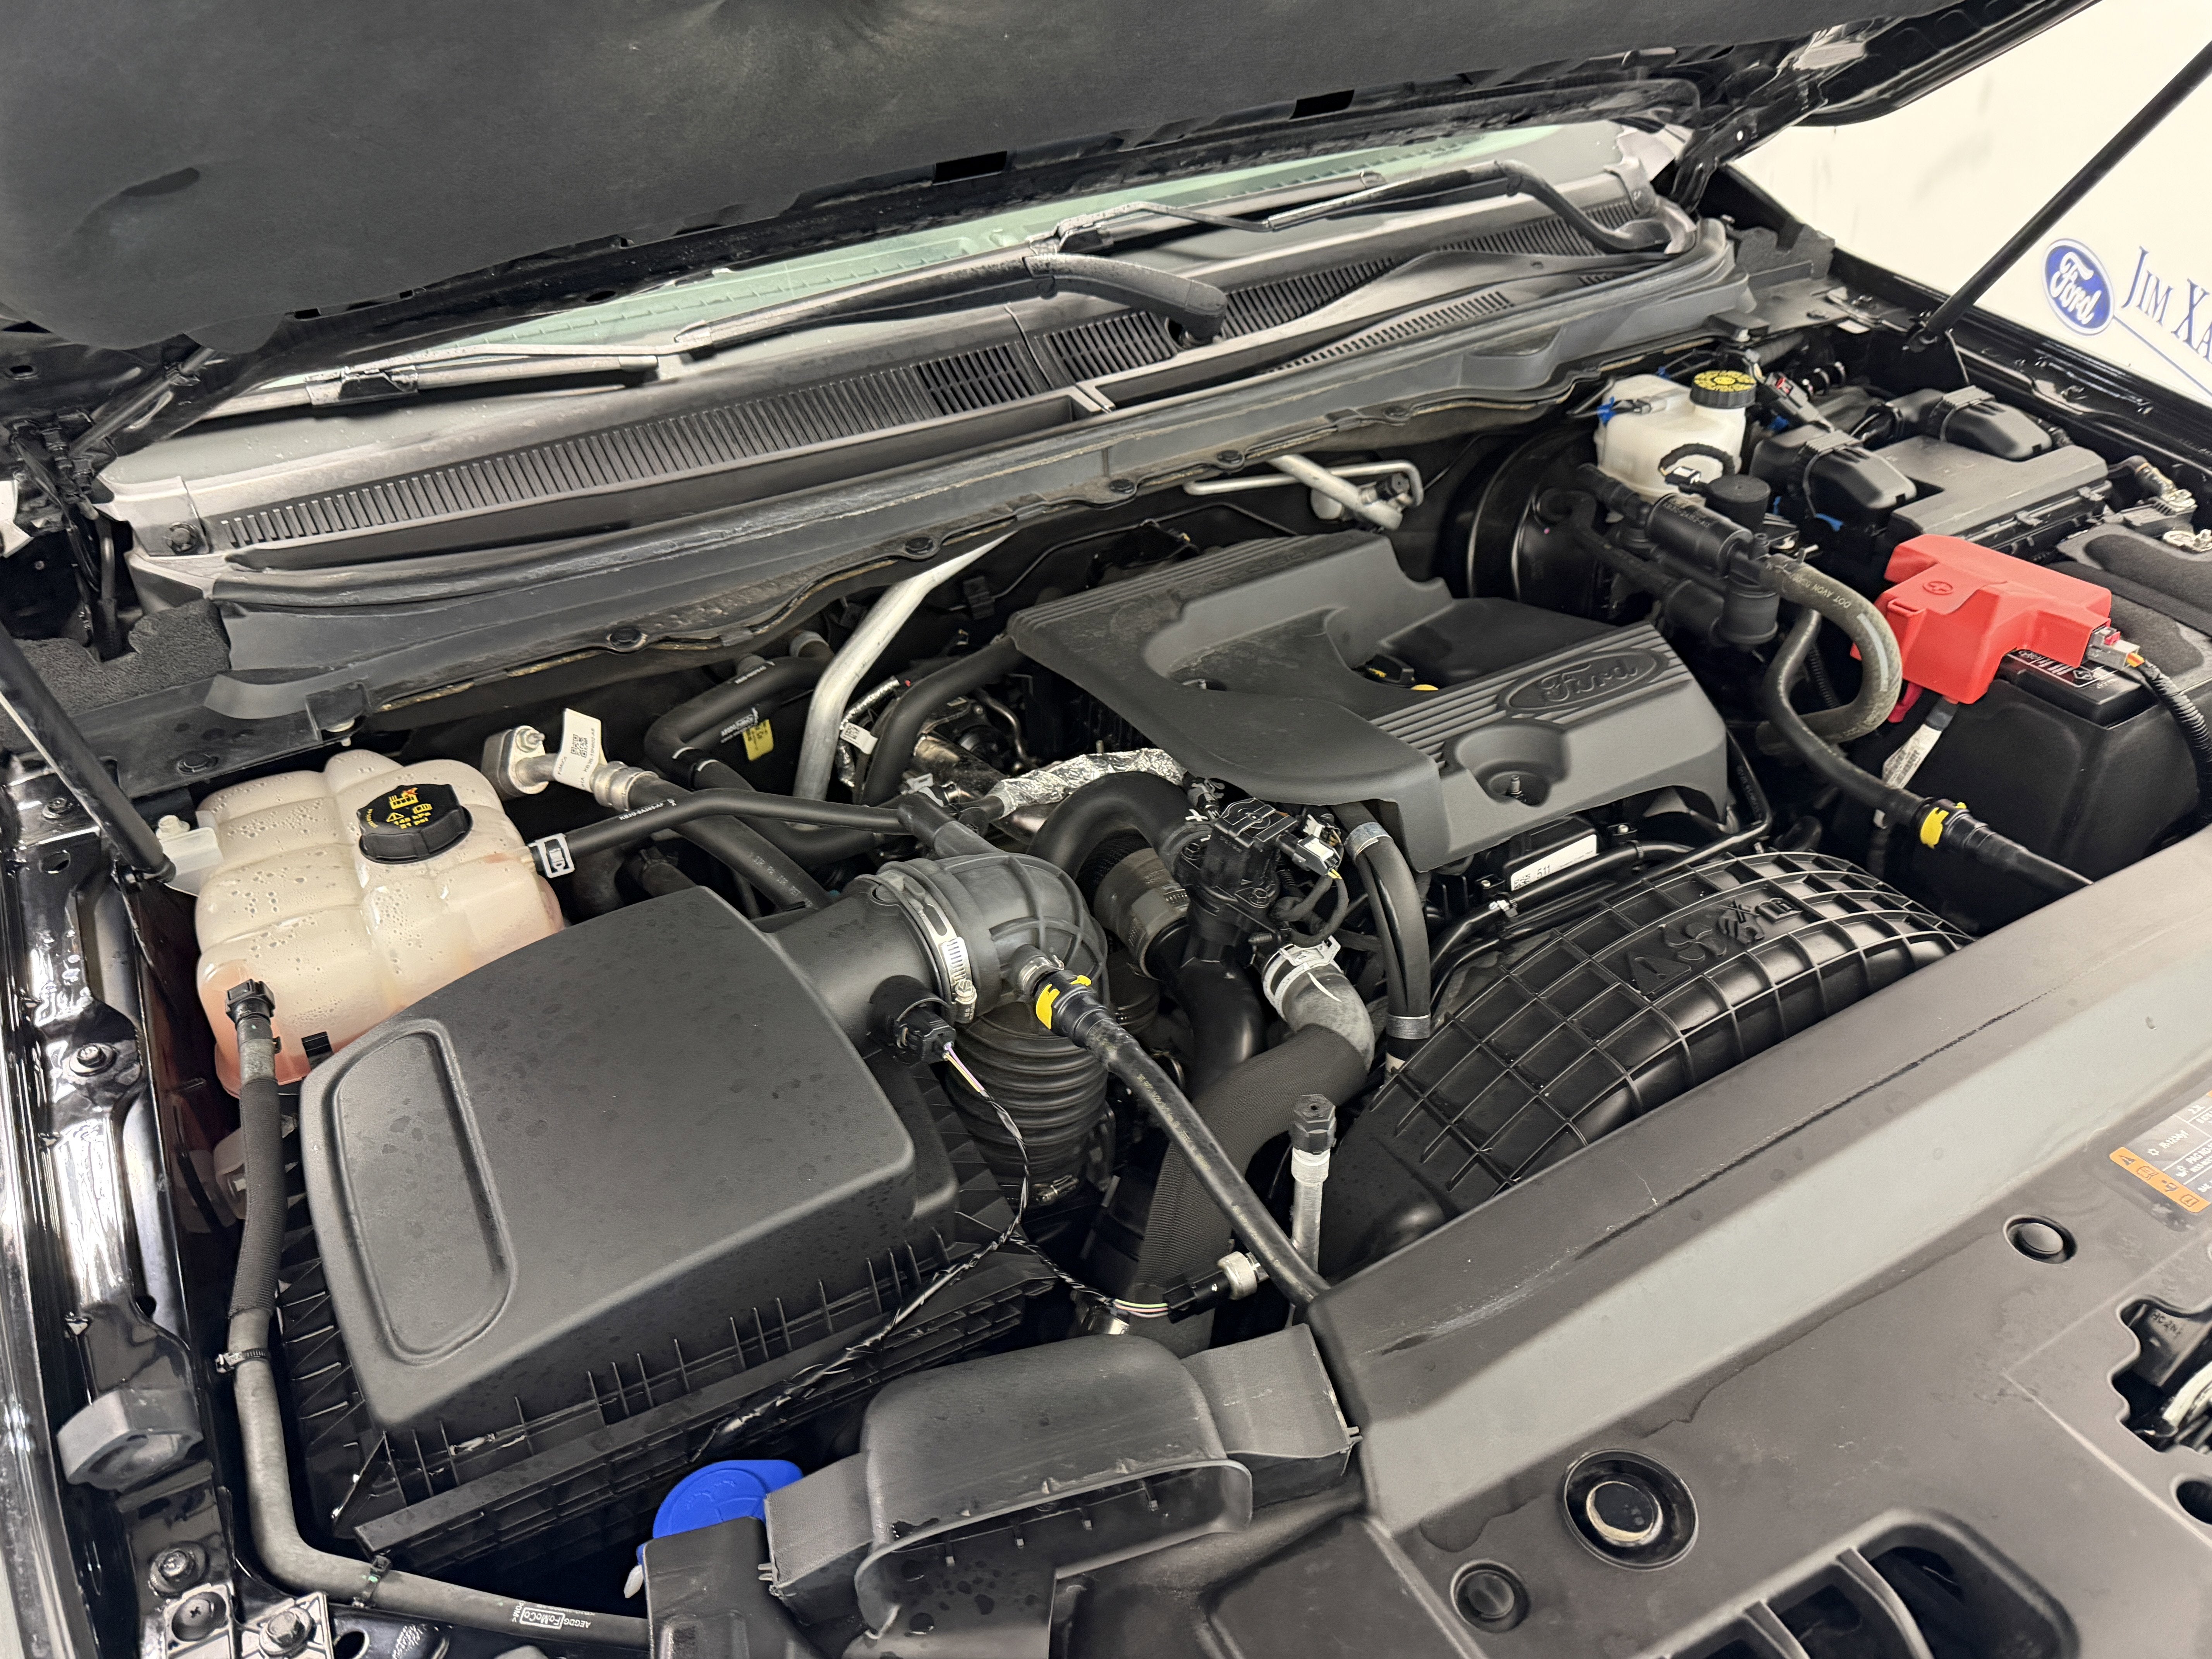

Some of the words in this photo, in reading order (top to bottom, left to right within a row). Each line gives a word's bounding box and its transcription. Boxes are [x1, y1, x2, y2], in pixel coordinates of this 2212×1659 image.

[2050, 251, 2102, 325] Ford
[1810, 584, 1834, 598] AVON
[1833, 596, 1851, 608] DOT
[523, 1610, 561, 1626] FoMoCo
[563, 1618, 591, 1628] AEGDG
